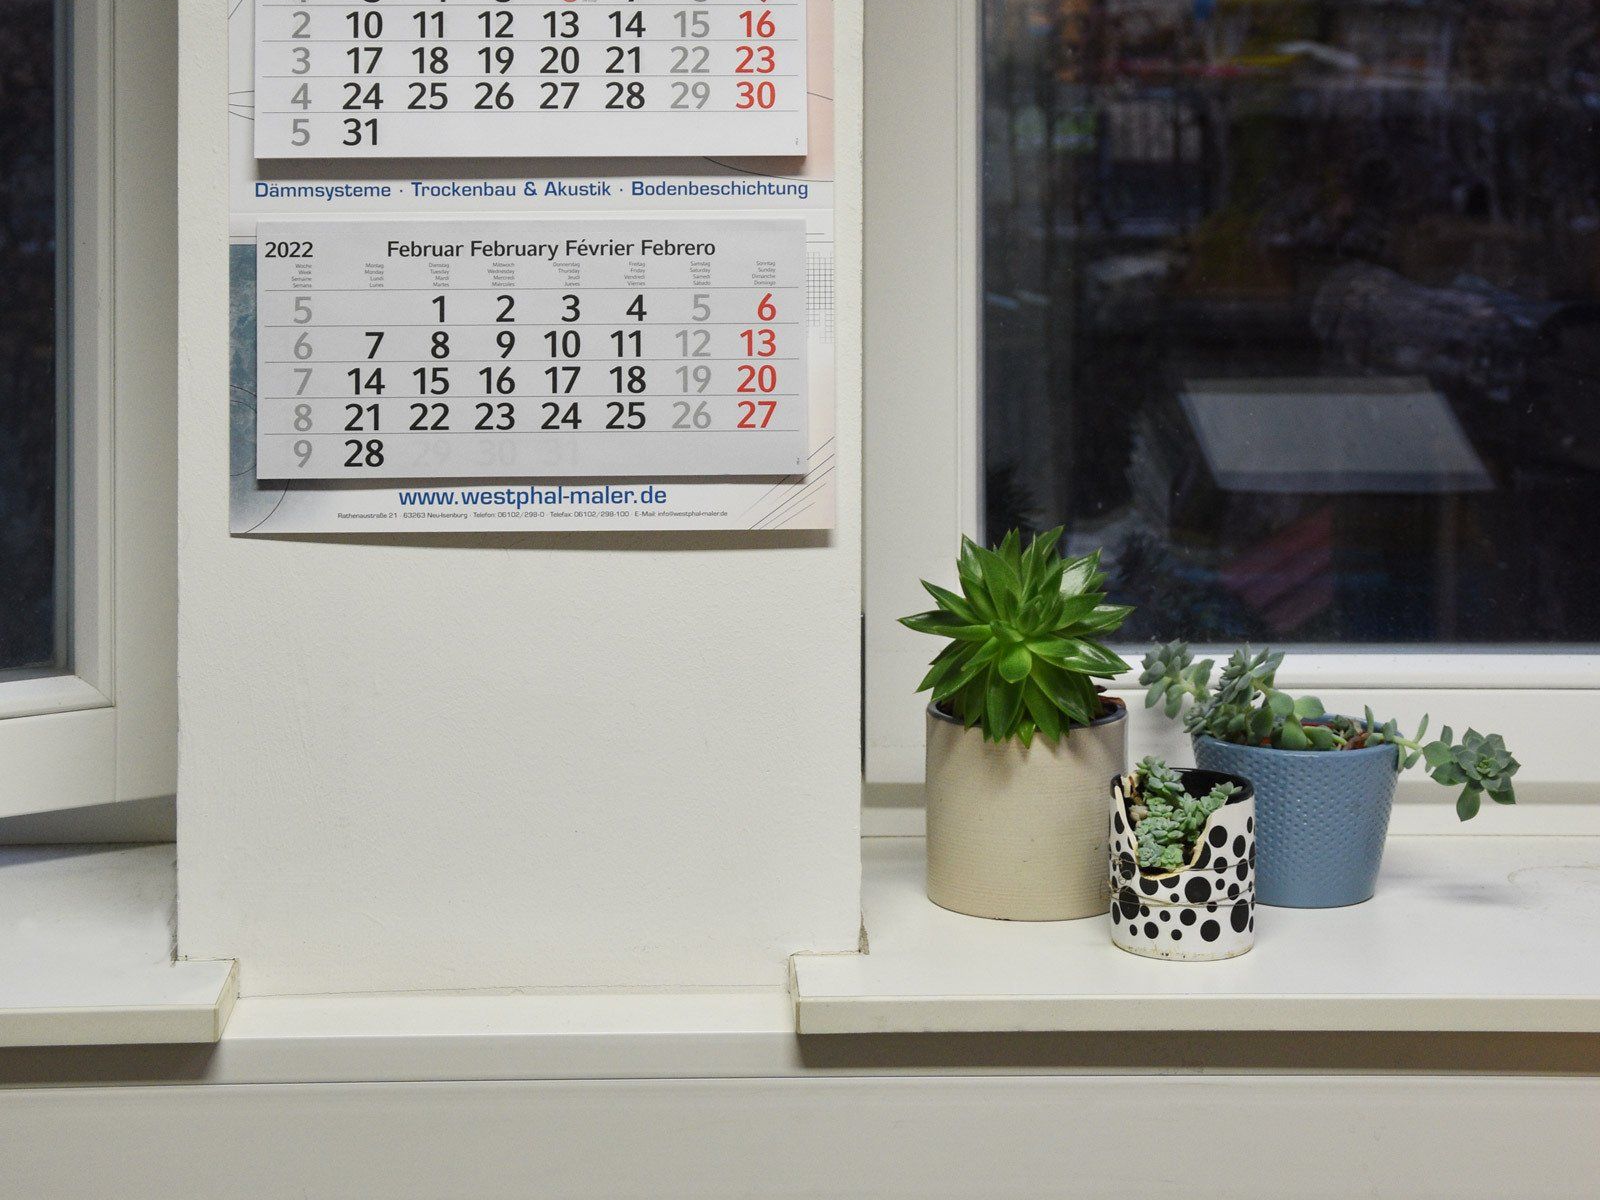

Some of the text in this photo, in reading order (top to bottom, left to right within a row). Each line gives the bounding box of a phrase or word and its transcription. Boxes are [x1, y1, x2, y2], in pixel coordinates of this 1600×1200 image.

[292, 10, 775, 38] 2 10 11 12 13 14 15 16
[291, 81, 775, 110] 4 24 25 26 27 28 29 30
[291, 118, 377, 146] 5 31
[256, 180, 809, 201] Dämmsysteme Trockenbau & Akustik Bodenbeschichtung
[265, 239, 715, 260] 2022 Februar February Février Febrero
[294, 293, 776, 323] 5 1 2 3 4 5 6
[294, 329, 776, 359] 6 7 8 9 10 11 12 13
[294, 365, 776, 394] 7 14 15 16 17 18 19 20
[294, 439, 384, 468] 9 28
[398, 485, 667, 509] www.westphal-maler.de
